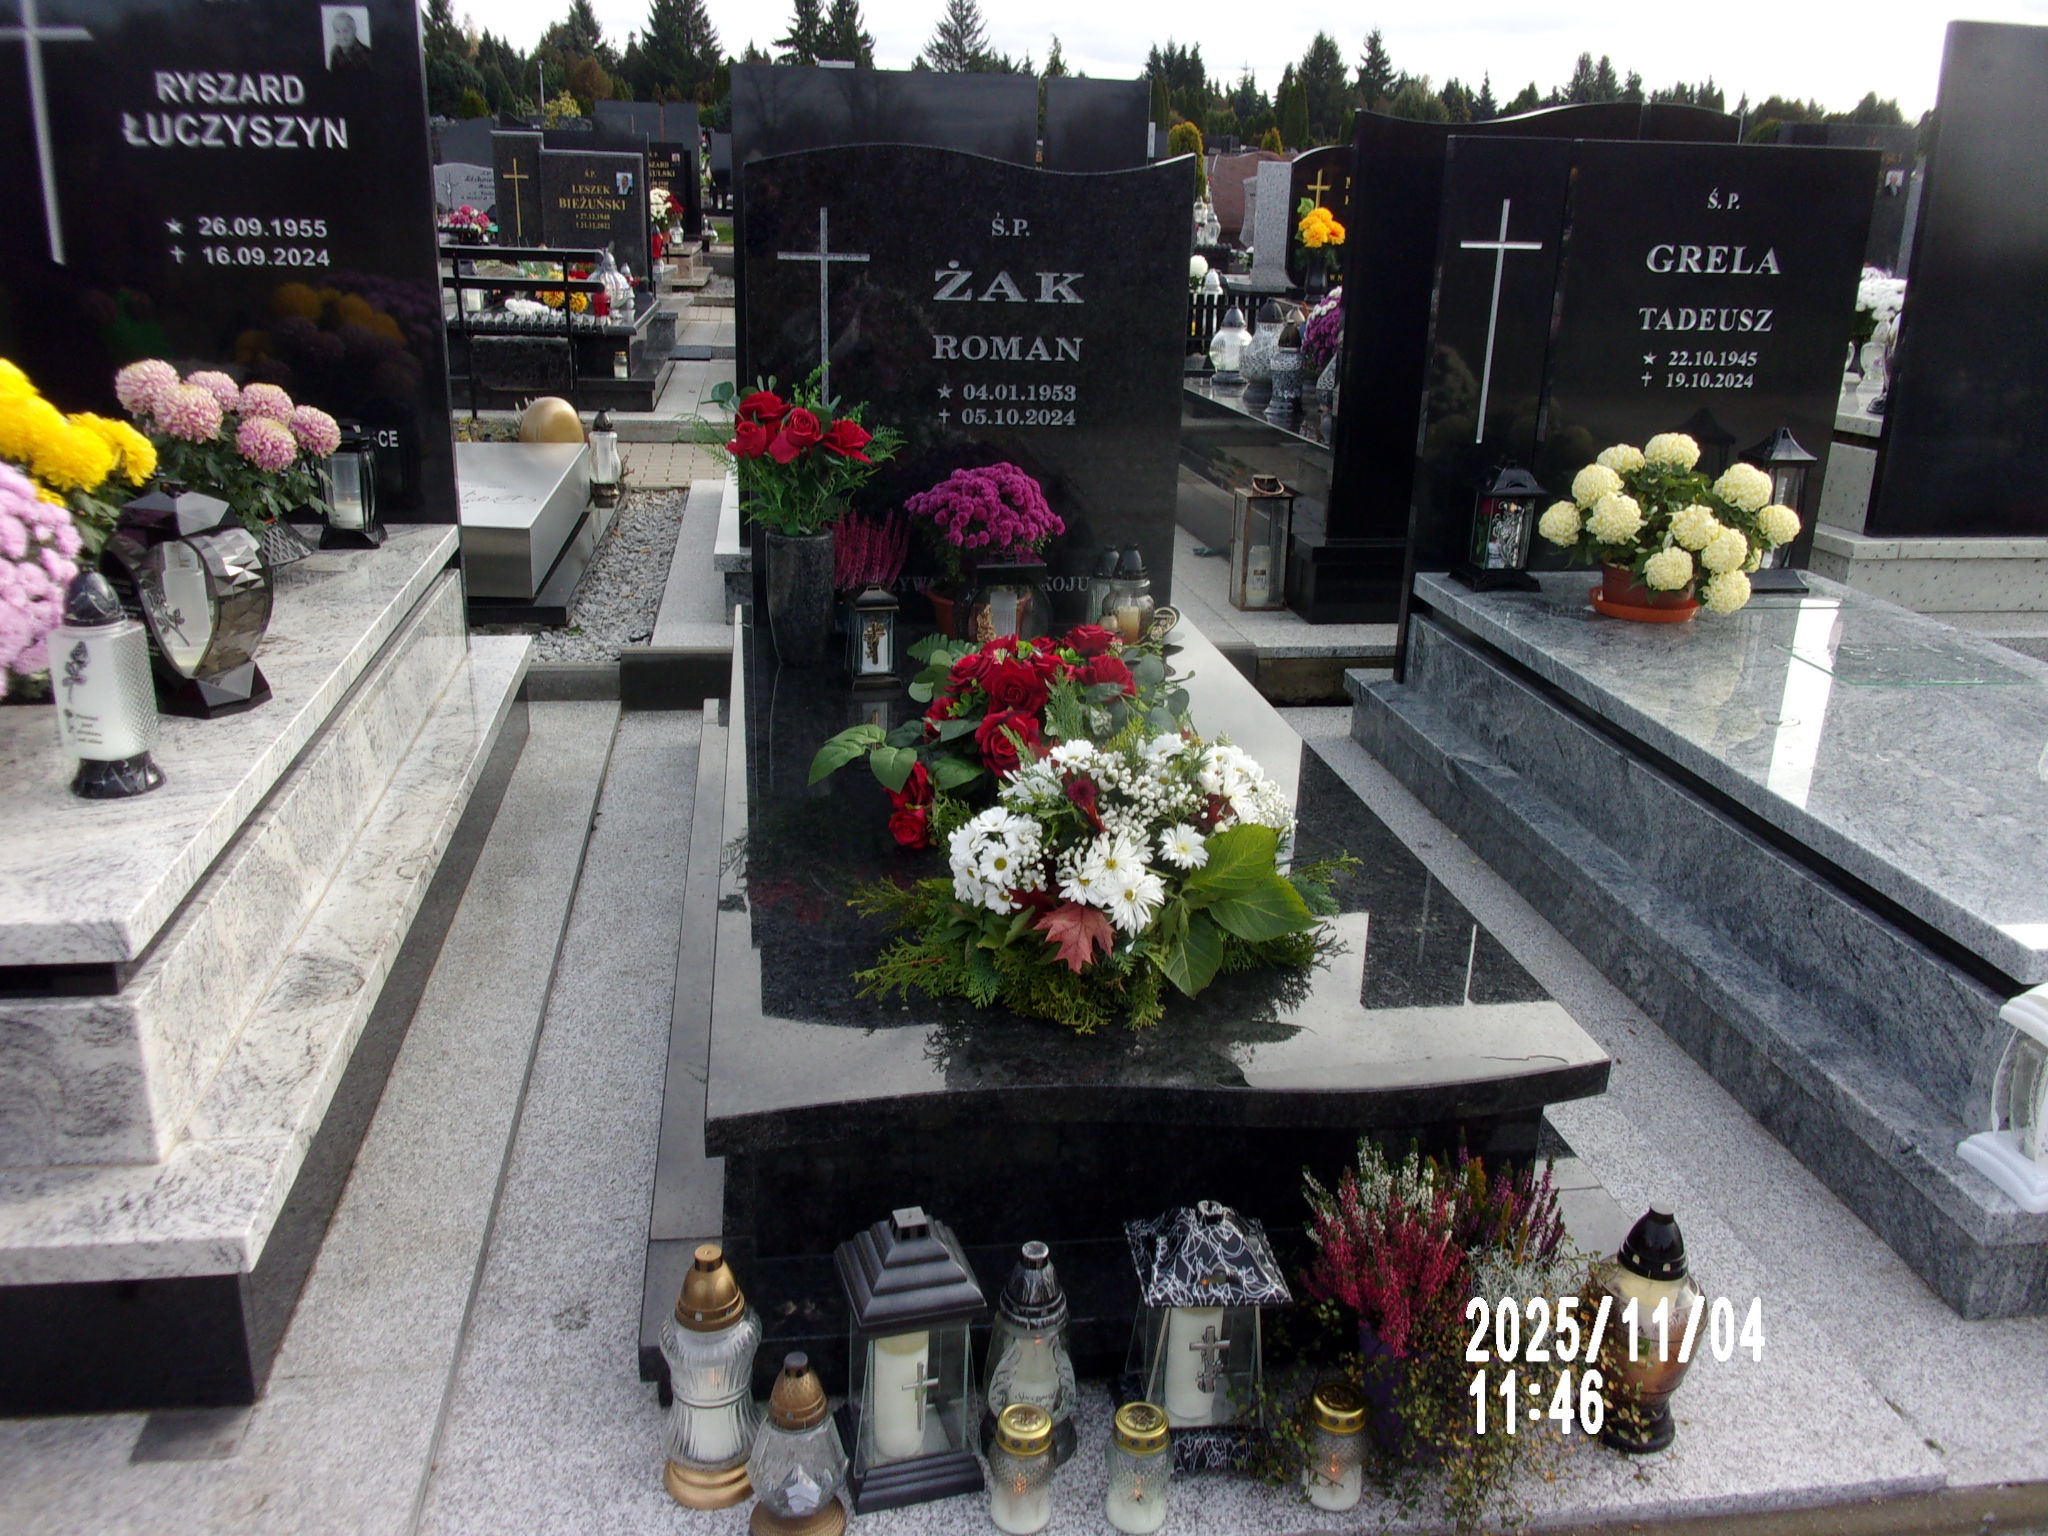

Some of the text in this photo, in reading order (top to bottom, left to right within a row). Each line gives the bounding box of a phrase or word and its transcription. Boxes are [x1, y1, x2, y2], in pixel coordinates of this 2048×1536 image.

[154, 71, 305, 105] RYSZARD
[122, 113, 349, 149] ŁUCZYSZYN
[572, 184, 610, 195] LESZEK
[559, 196, 626, 211] BIEŻUŃSKI
[198, 216, 328, 238] 26.09.1955
[991, 211, 1031, 237] Ś.P.
[202, 246, 331, 267] 16.09.2024
[1646, 244, 1781, 275] GRELA
[932, 260, 1085, 304] ŻAK
[1638, 307, 1774, 332] TADEUSZ
[932, 334, 1084, 362] ROMAN
[1668, 351, 1758, 366] 22.10.1945
[1666, 372, 1754, 388] 19.10.2024
[963, 384, 1077, 401] 04.01.1953
[961, 408, 1077, 426] 05.10.2024
